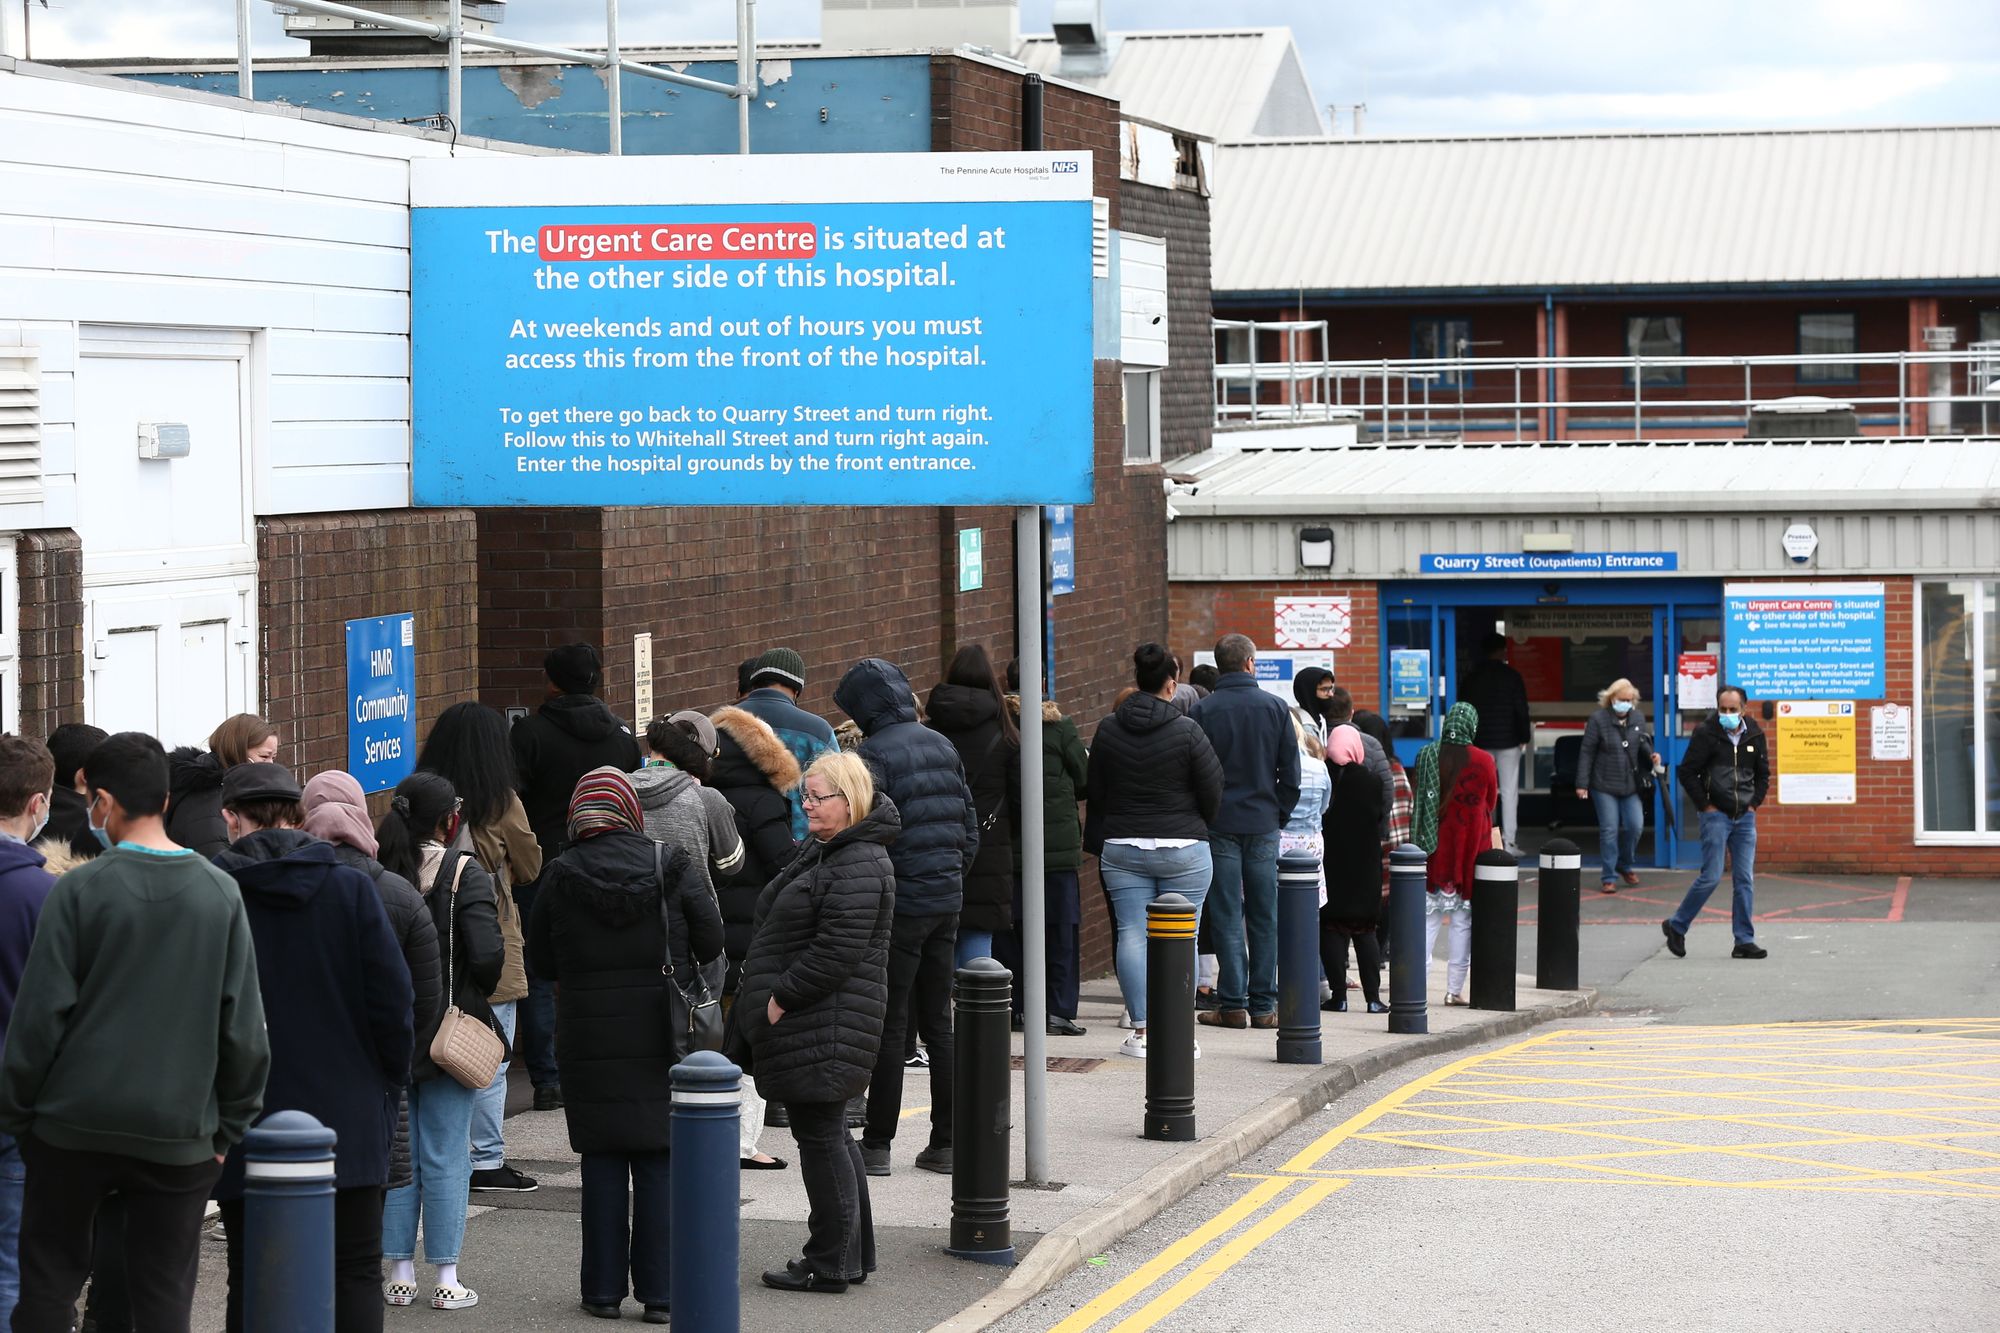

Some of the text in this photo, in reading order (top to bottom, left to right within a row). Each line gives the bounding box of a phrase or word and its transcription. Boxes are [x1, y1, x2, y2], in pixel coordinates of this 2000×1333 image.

[940, 162, 1077, 175] The Pennine Acute Hospitals NHS
[485, 224, 1005, 258] The Urgent Care Centre is situated at
[533, 261, 955, 292] the other side of this hospital.
[510, 315, 982, 340] At weekends and out of hours you must
[506, 345, 986, 371] access this from the front of the hospital.
[499, 404, 992, 427] To get there go back to Quarry Street and turn right.
[505, 429, 988, 450] Follow this to Whitehall Street and turn right again.
[517, 453, 976, 475] Enter the hospital grounds by the front entrance.
[1434, 555, 1663, 571] Quarry Street (Outpatients) Entrance
[1731, 602, 1746, 610] The
[1749, 602, 1779, 611] Urgent
[1781, 601, 1801, 609] Care
[1803, 601, 1832, 609] Centre
[1844, 600, 1880, 609] situated
[1745, 612, 1760, 620] the
[1762, 611, 1786, 620] other
[1788, 611, 1806, 620] side
[1808, 611, 1819, 620] of
[1820, 611, 1836, 620] this
[1838, 611, 1876, 622] hospital.
[1764, 622, 1779, 630] (see
[1792, 623, 1807, 631] map
[1818, 621, 1830, 629] the
[1831, 621, 1846, 629] left)
[1749, 638, 1783, 646] weekends
[1784, 638, 1797, 646] and
[1840, 639, 1853, 647] you
[1791, 646, 1803, 654] the
[1804, 646, 1821, 654] front
[1843, 646, 1872, 655] hospital.
[371, 648, 393, 677] HMR
[1746, 664, 1758, 672] get
[1778, 664, 1788, 672] go
[1814, 663, 1838, 671] Quarry
[1861, 662, 1874, 670] and
[1752, 672, 1769, 680] right.
[1771, 679, 1788, 688] right
[1789, 680, 1809, 688] again.
[1843, 679, 1870, 687] hospital
[1755, 687, 1783, 696] grounds
[1784, 688, 1793, 696] by
[356, 687, 409, 723] Community
[365, 732, 401, 764] Services
[1804, 740, 1829, 748] Parking
